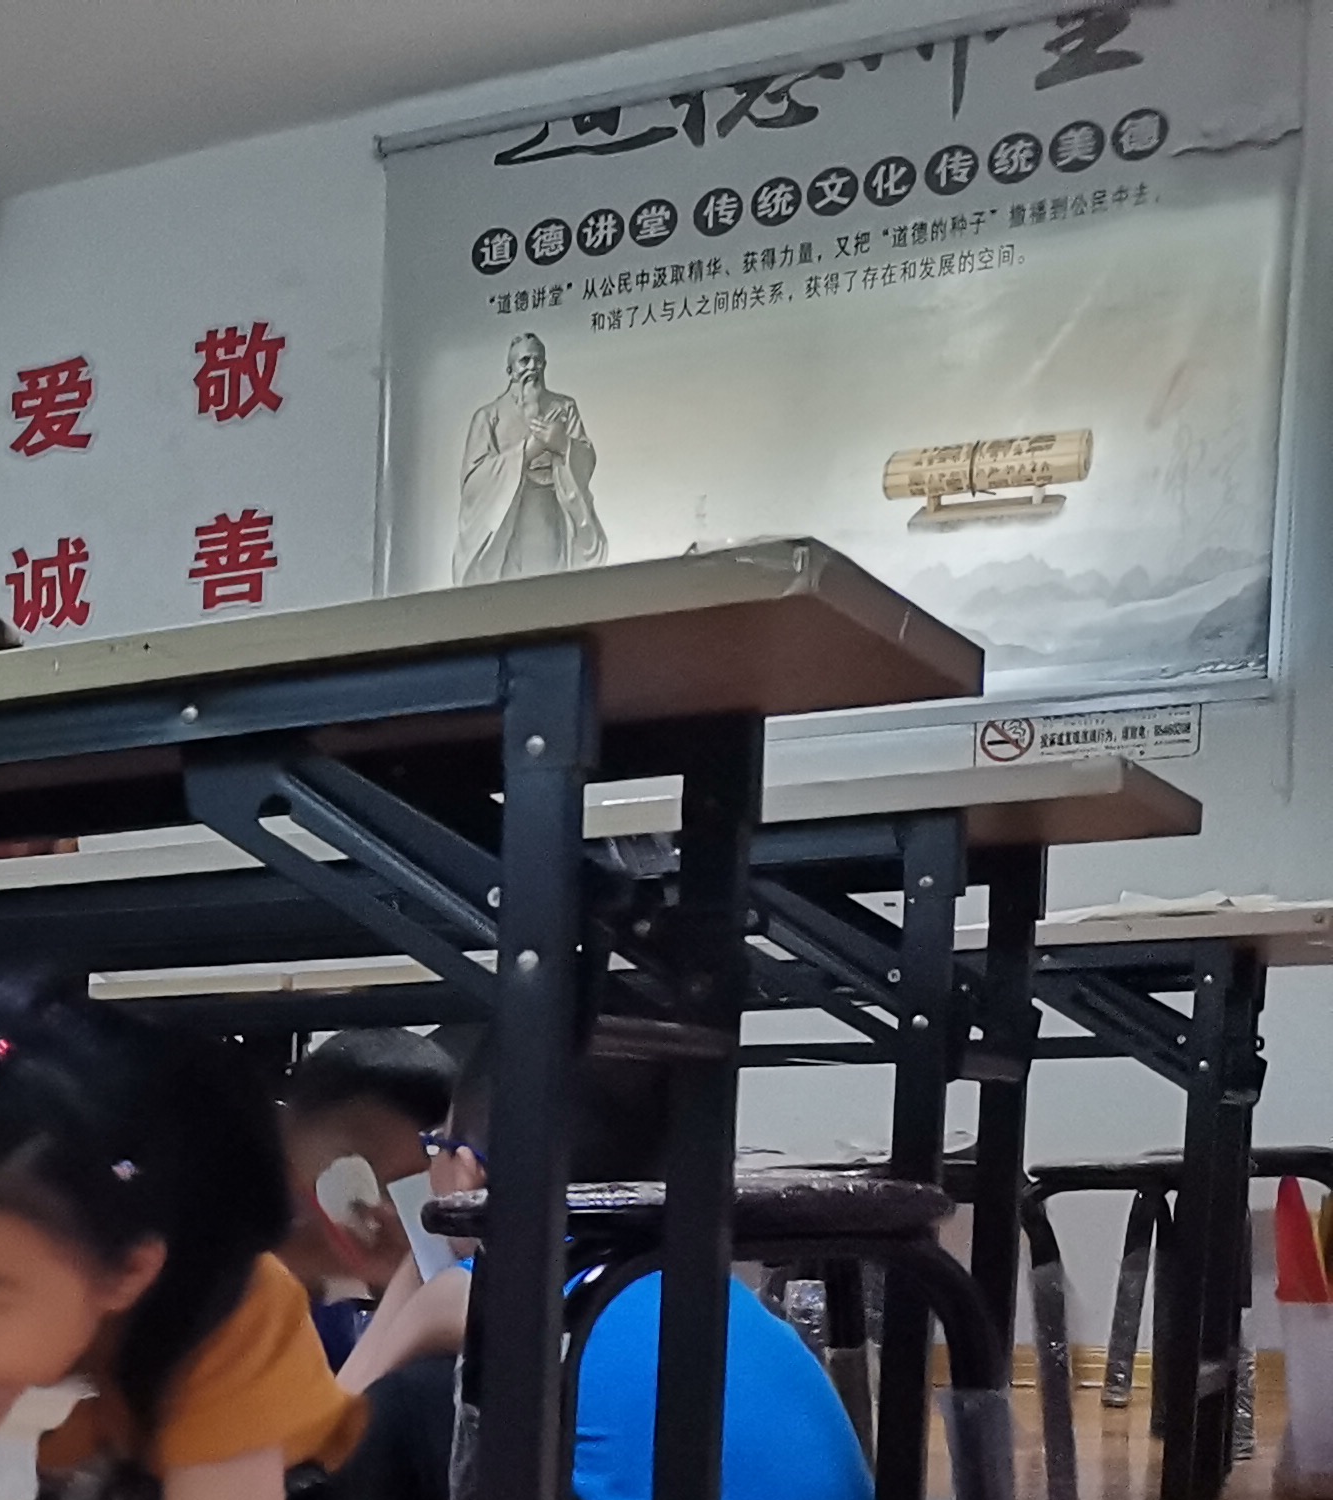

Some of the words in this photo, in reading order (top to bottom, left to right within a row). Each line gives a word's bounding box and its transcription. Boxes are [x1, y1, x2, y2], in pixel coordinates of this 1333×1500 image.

[475, 202, 674, 271] 道德讲堂
[9, 356, 93, 457] 爱
[194, 321, 286, 422] 敬
[5, 537, 91, 633] 诚
[188, 509, 277, 610] 善
